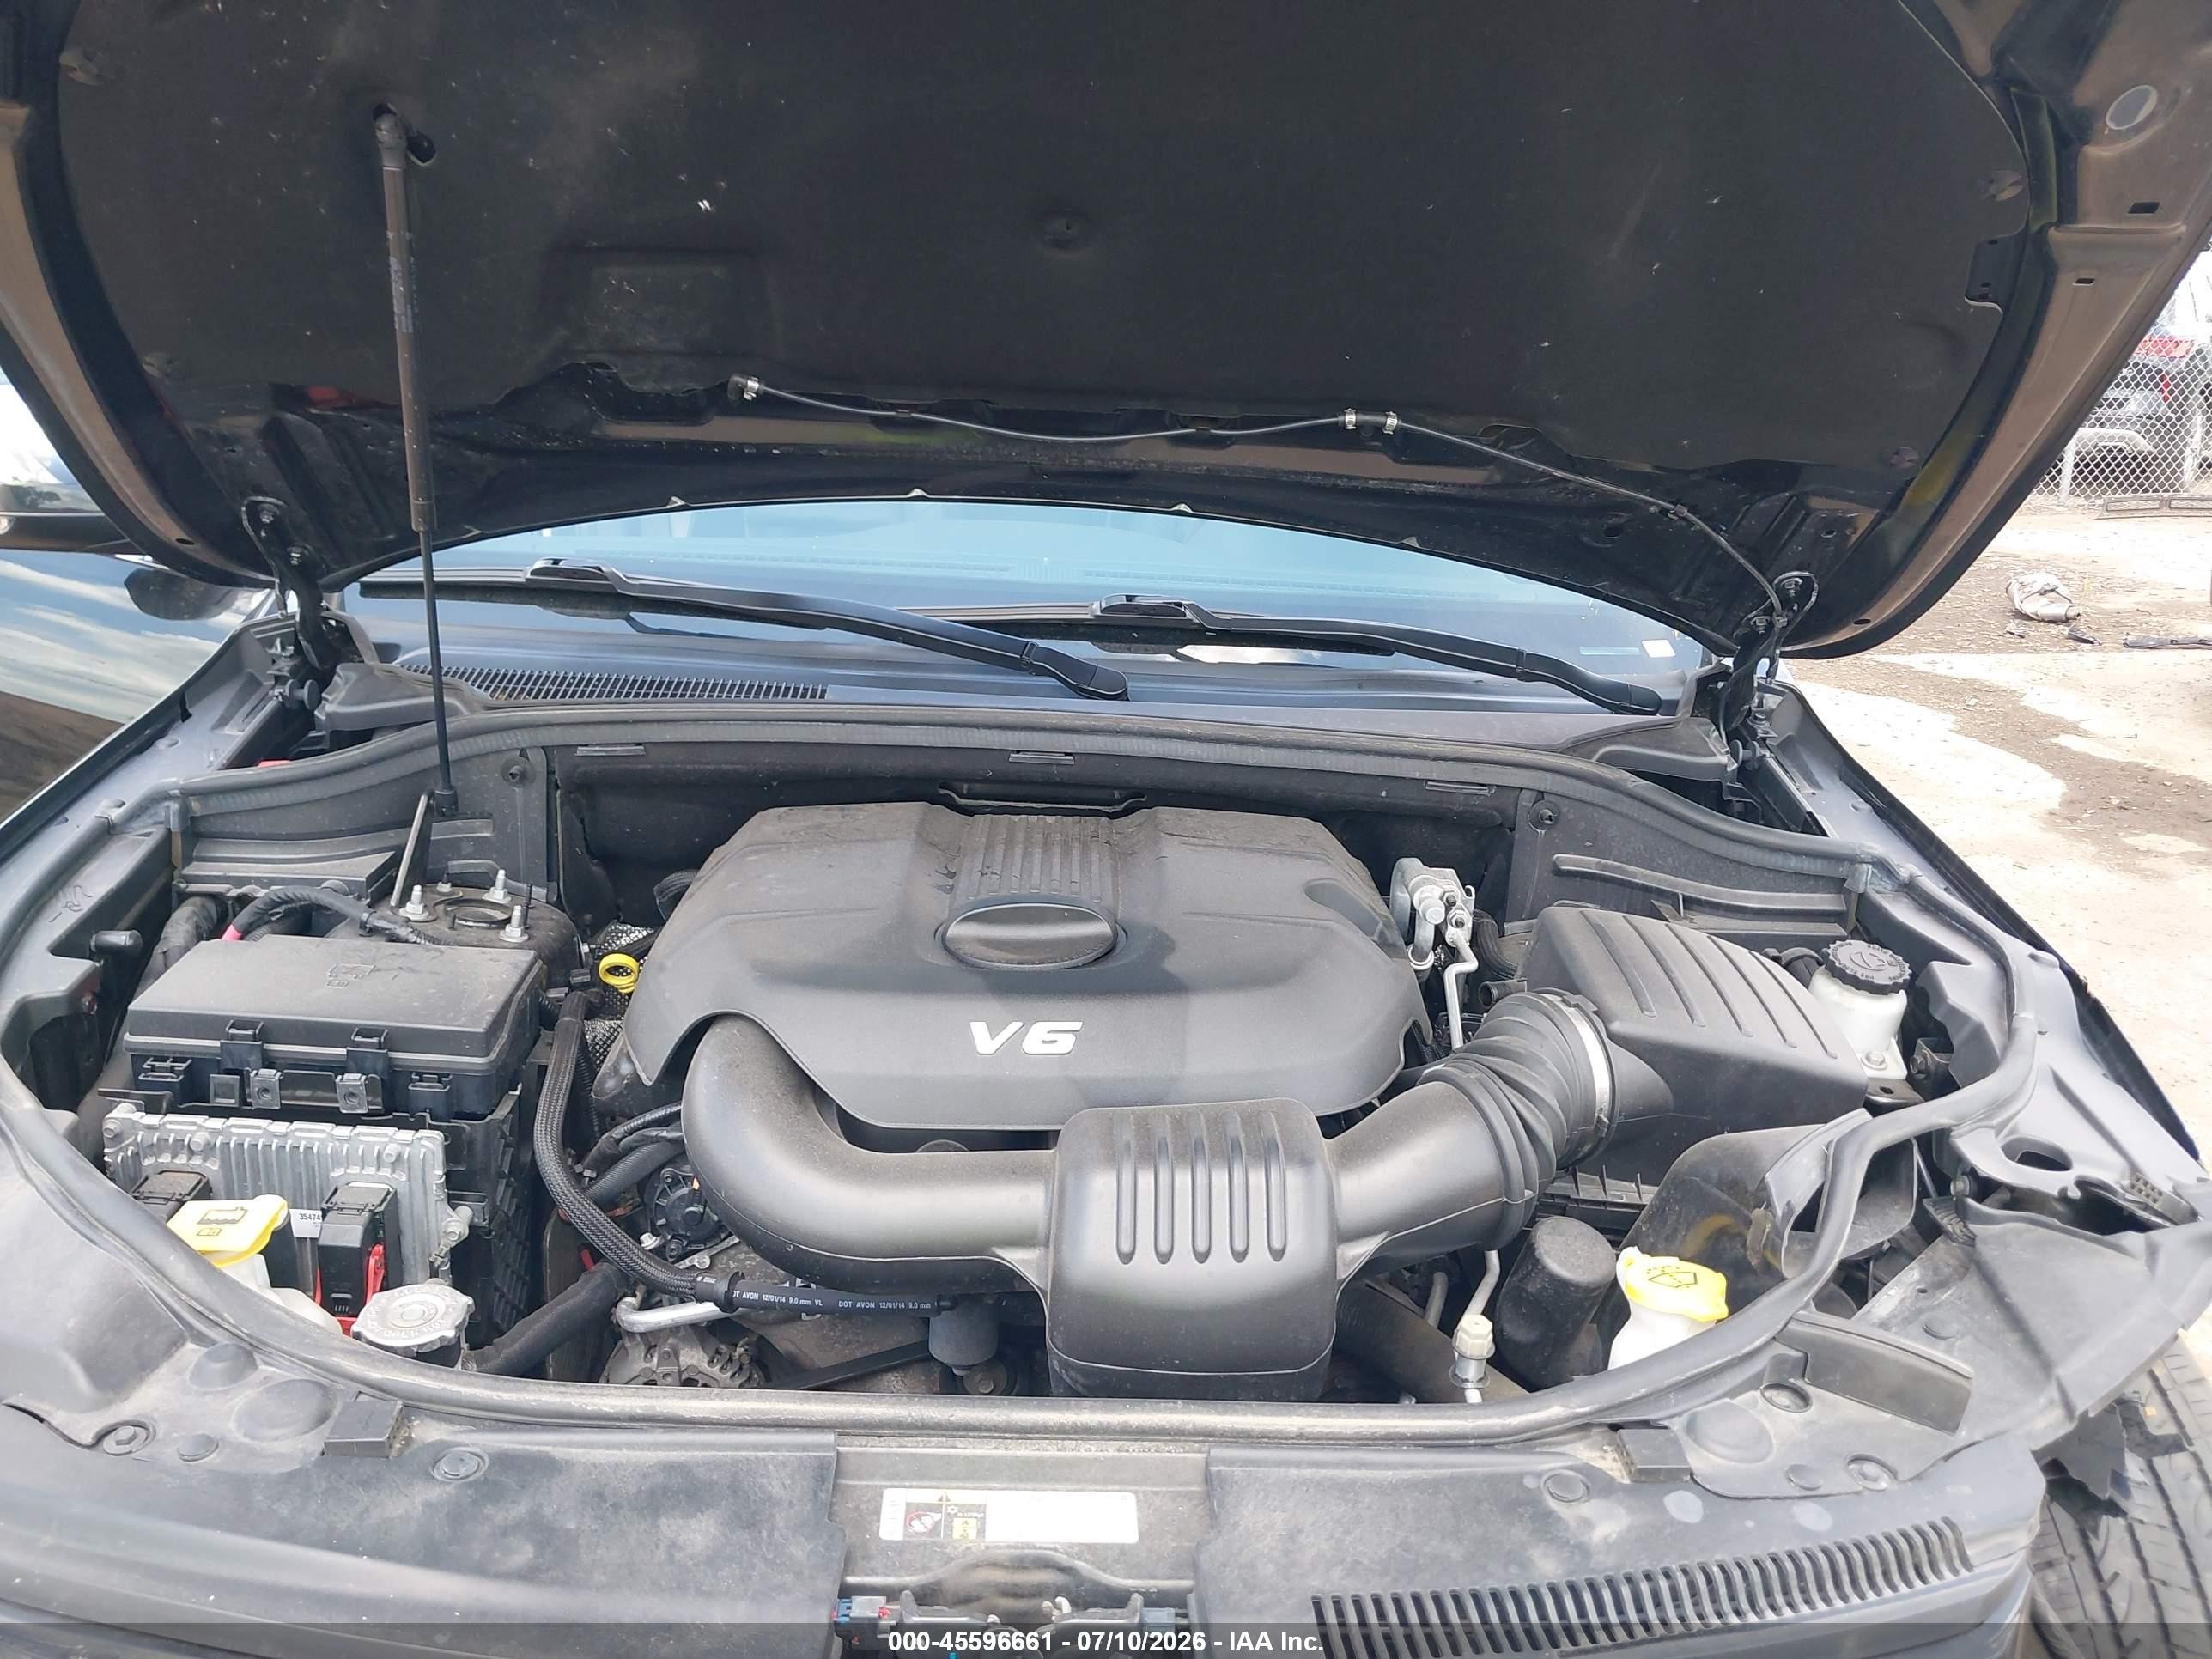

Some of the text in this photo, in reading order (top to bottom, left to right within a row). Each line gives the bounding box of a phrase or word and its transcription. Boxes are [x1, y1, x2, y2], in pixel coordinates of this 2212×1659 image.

[969, 1021, 1085, 1055] V6
[742, 1291, 759, 1300] AVON
[763, 1294, 786, 1303] 12/01/14
